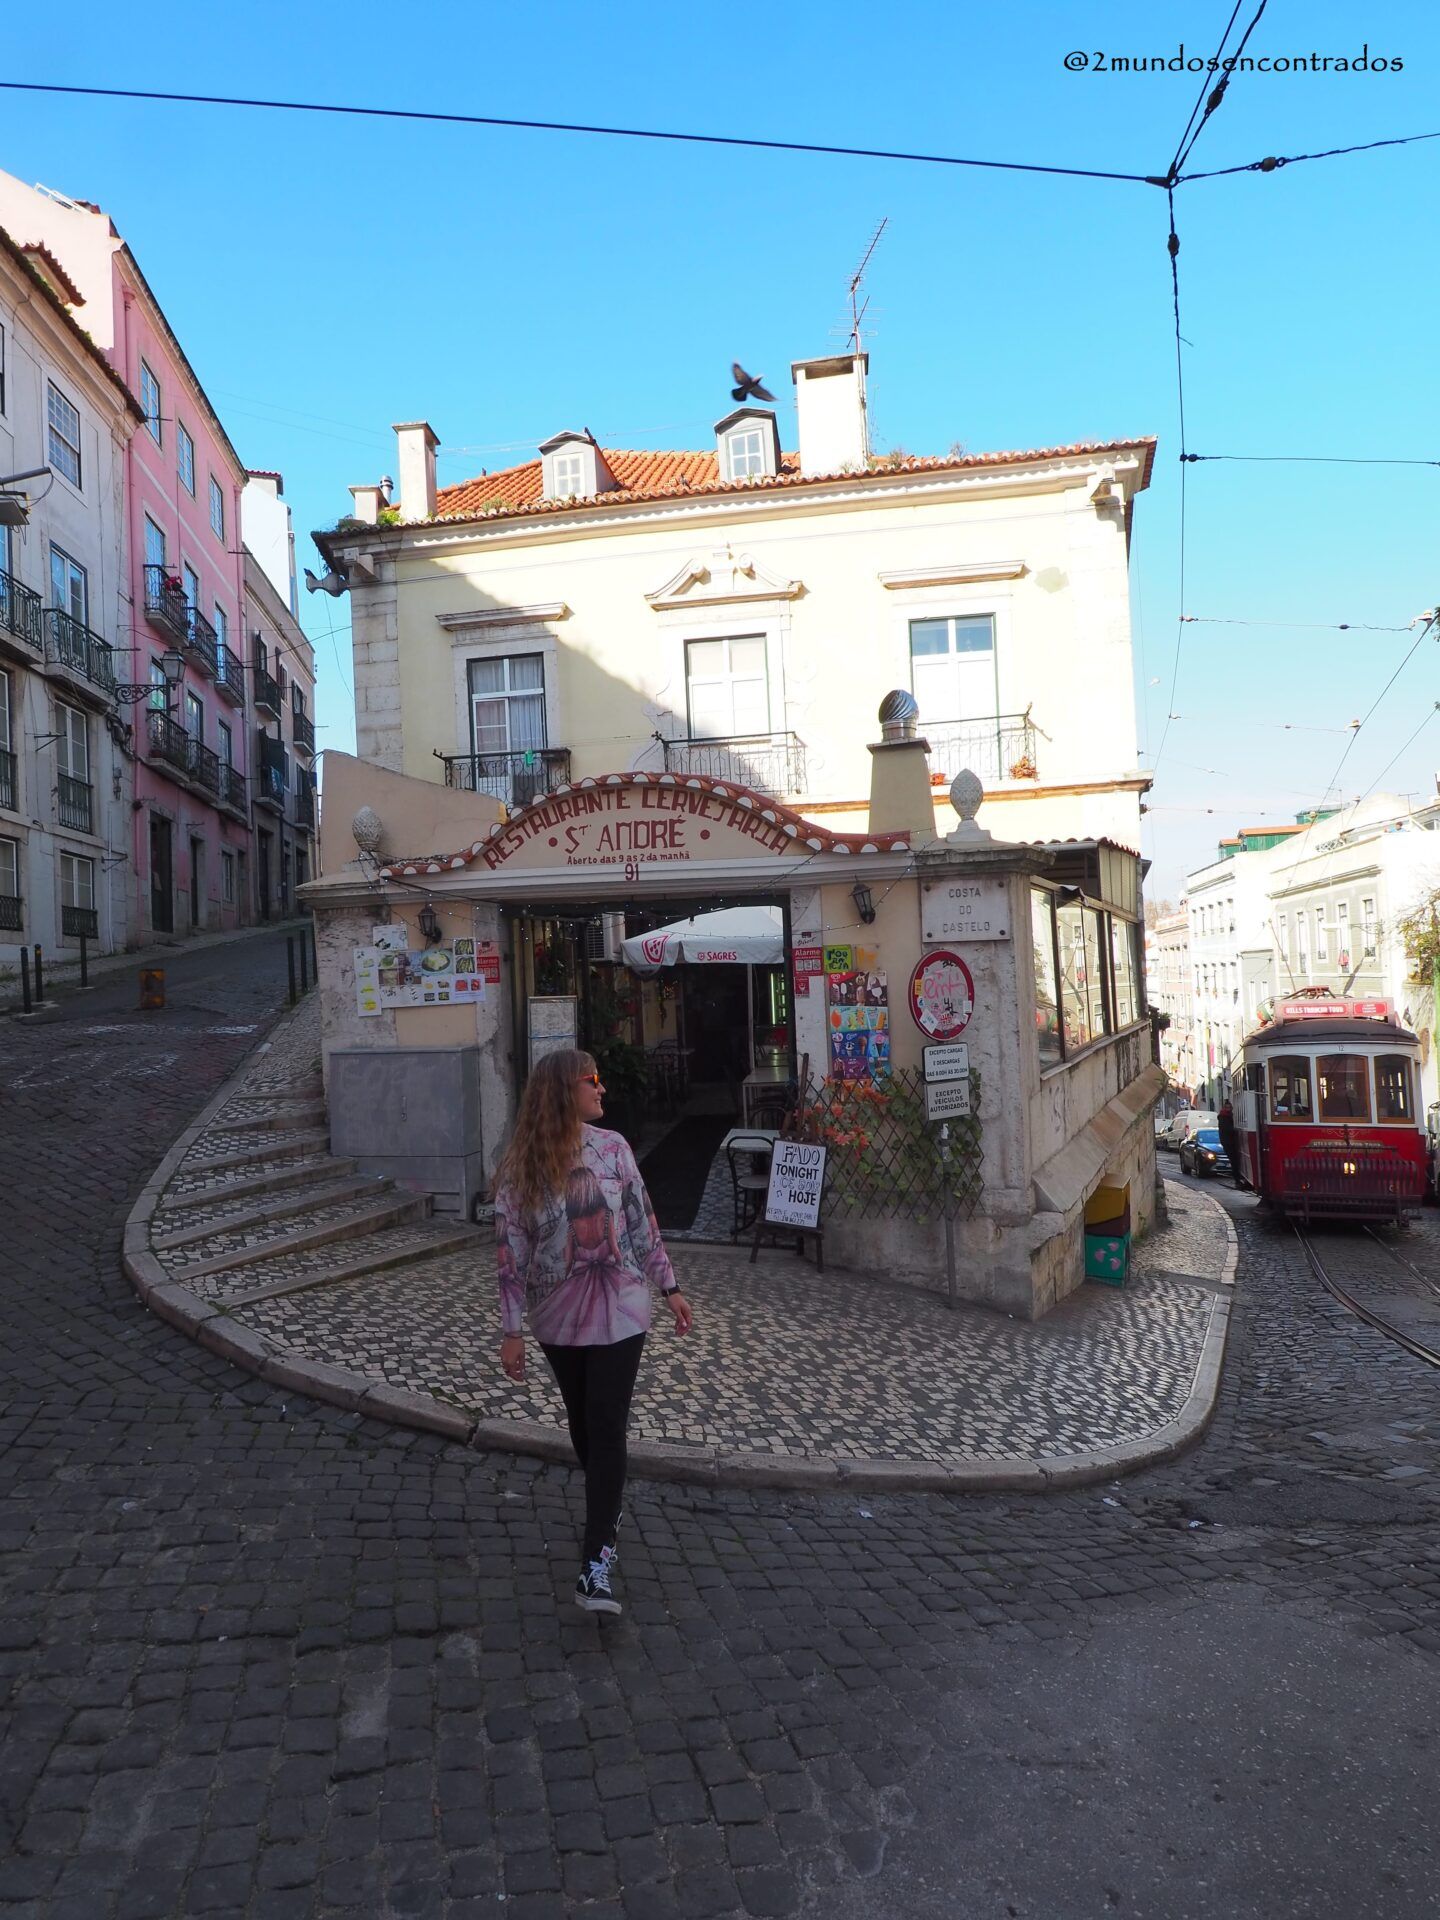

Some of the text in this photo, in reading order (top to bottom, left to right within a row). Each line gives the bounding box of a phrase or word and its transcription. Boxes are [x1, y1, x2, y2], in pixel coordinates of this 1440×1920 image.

[482, 786, 792, 870] RESTAURANTE CERVEJARIA
[595, 815, 687, 852] ANDRÉ
[567, 855, 598, 865] Aberto
[600, 855, 617, 864] das
[618, 854, 624, 863] 9
[626, 854, 638, 862] as
[640, 853, 645, 862] 2
[646, 852, 658, 861] da
[624, 863, 639, 881] 91
[949, 888, 981, 898] COSTA
[959, 905, 972, 915] DO
[942, 921, 990, 933] CASTELO
[707, 951, 737, 961] SAGRES
[935, 1088, 961, 1097] EXCEPTO
[930, 1101, 969, 1112] AUTORIZADOS
[782, 1145, 821, 1166] FADO
[776, 1163, 819, 1180] TONIGHT
[788, 1189, 817, 1206] HOJE
